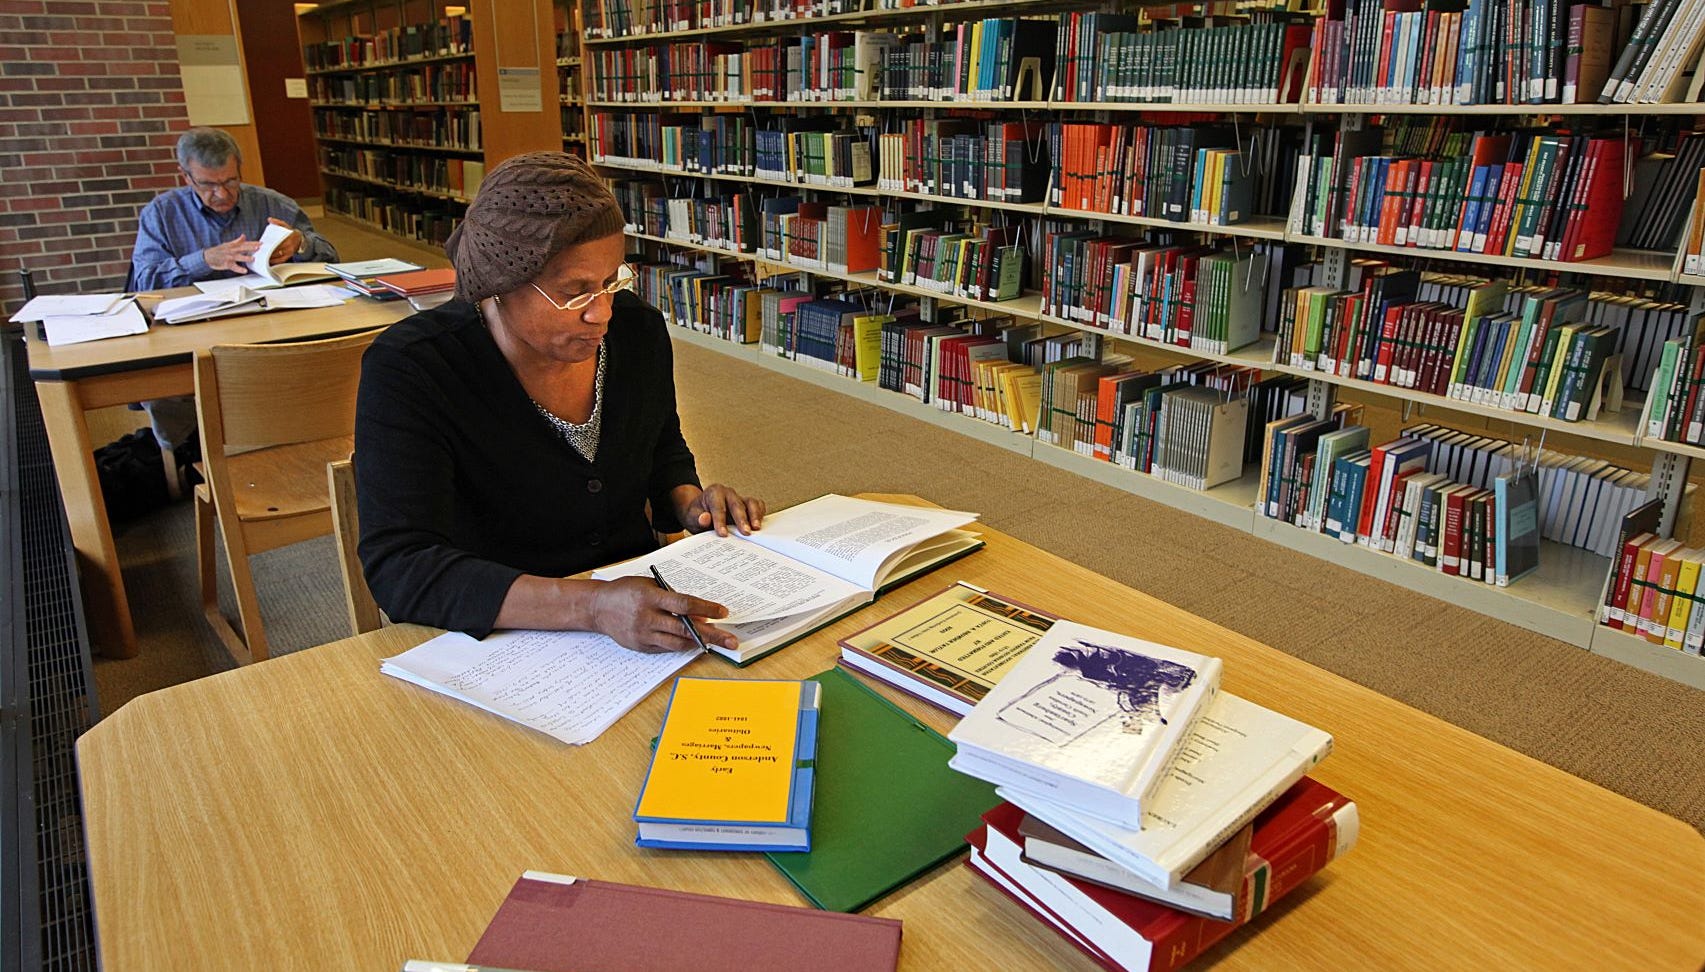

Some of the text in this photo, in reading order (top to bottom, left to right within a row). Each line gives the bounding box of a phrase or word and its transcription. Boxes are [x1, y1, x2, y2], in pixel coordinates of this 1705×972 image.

[681, 742, 721, 750] Marriages
[670, 752, 688, 760] S.C.
[691, 753, 729, 763] County,
[711, 766, 733, 774] Early
